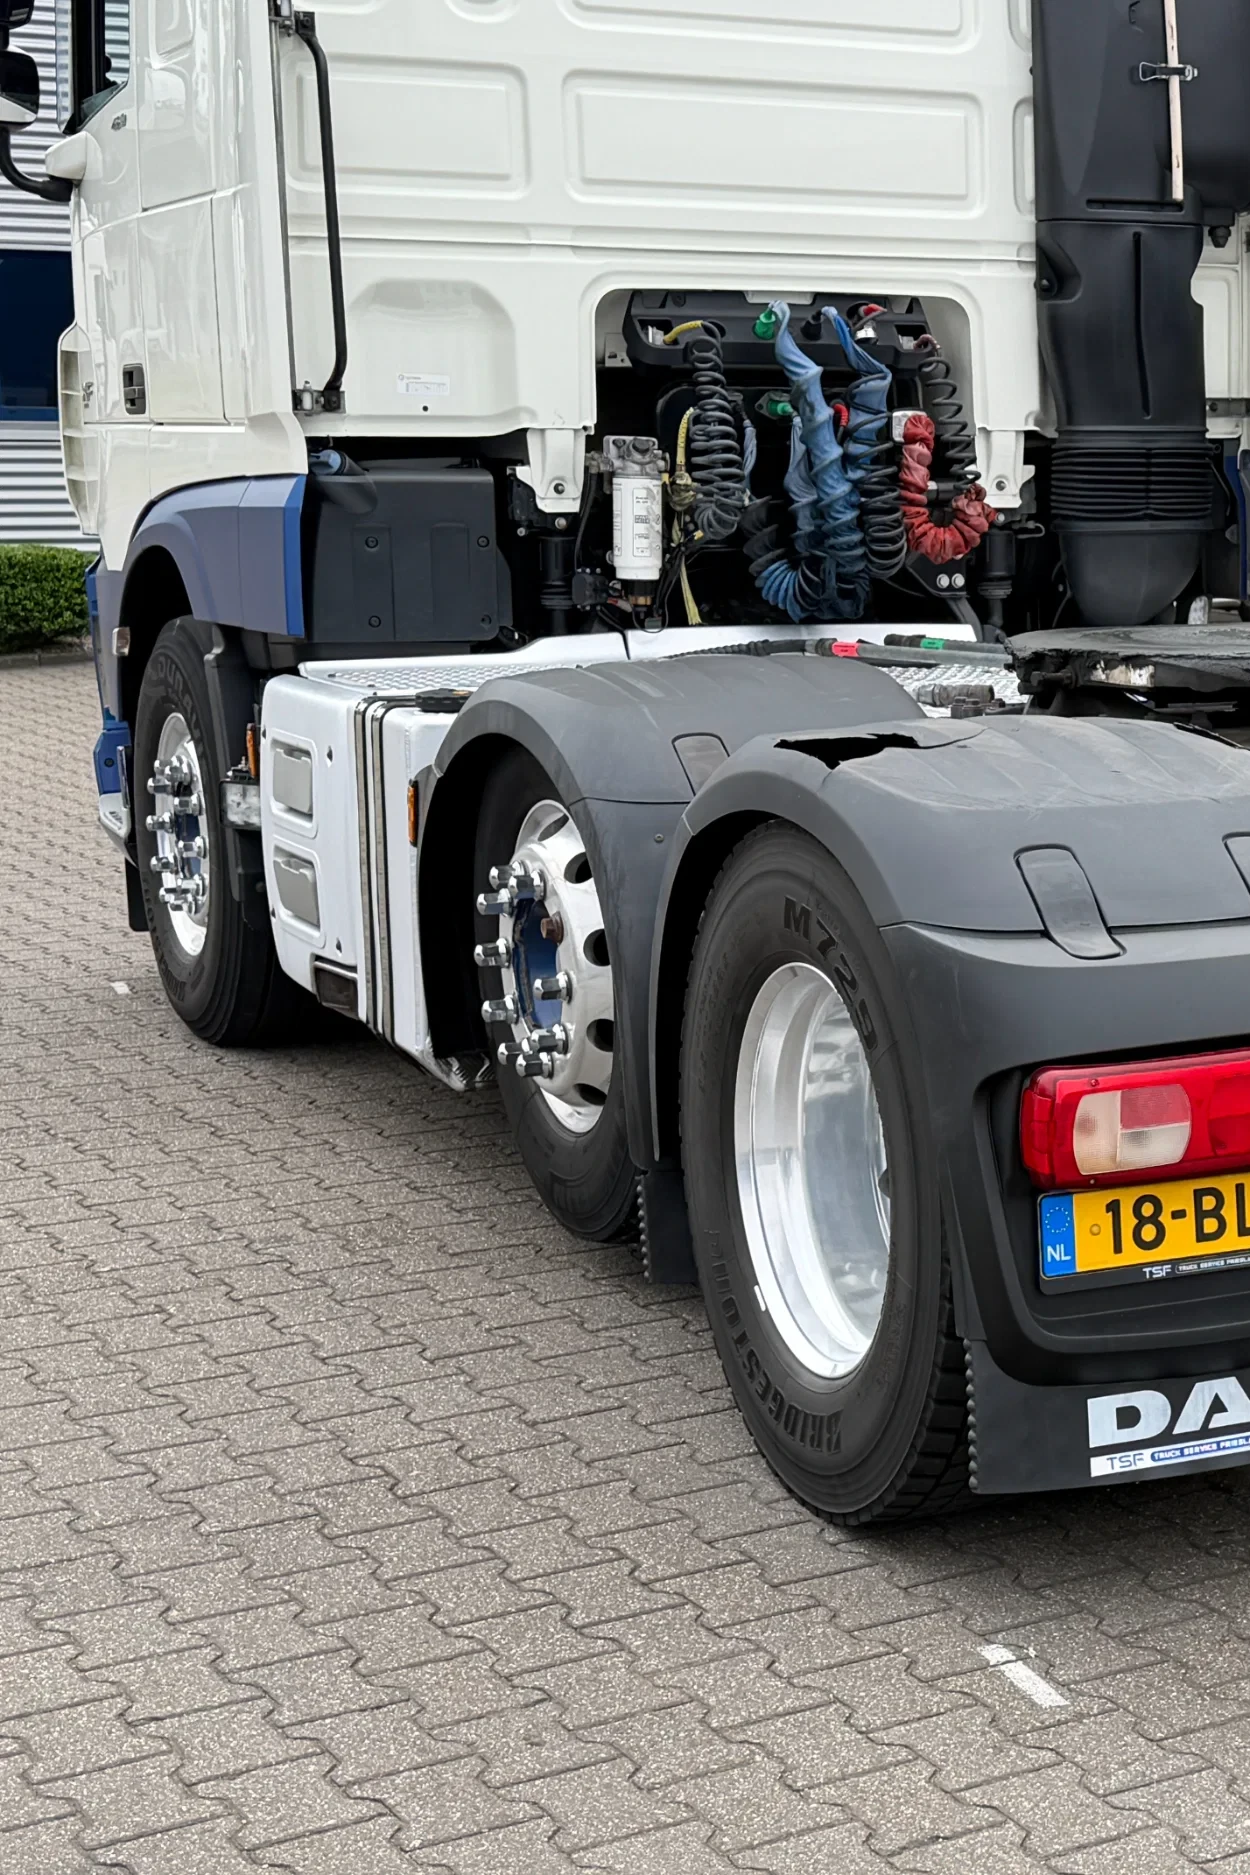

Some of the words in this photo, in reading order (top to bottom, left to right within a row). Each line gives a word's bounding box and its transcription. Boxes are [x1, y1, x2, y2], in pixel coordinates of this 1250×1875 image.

[784, 895, 878, 1050] M729
[1046, 1244, 1071, 1263] NL
[1142, 1265, 1172, 1279] TSF
[1106, 1452, 1145, 1471] TSF
[1153, 1450, 1181, 1460] TRUCK
[1183, 1443, 1218, 1456] SERVICE
